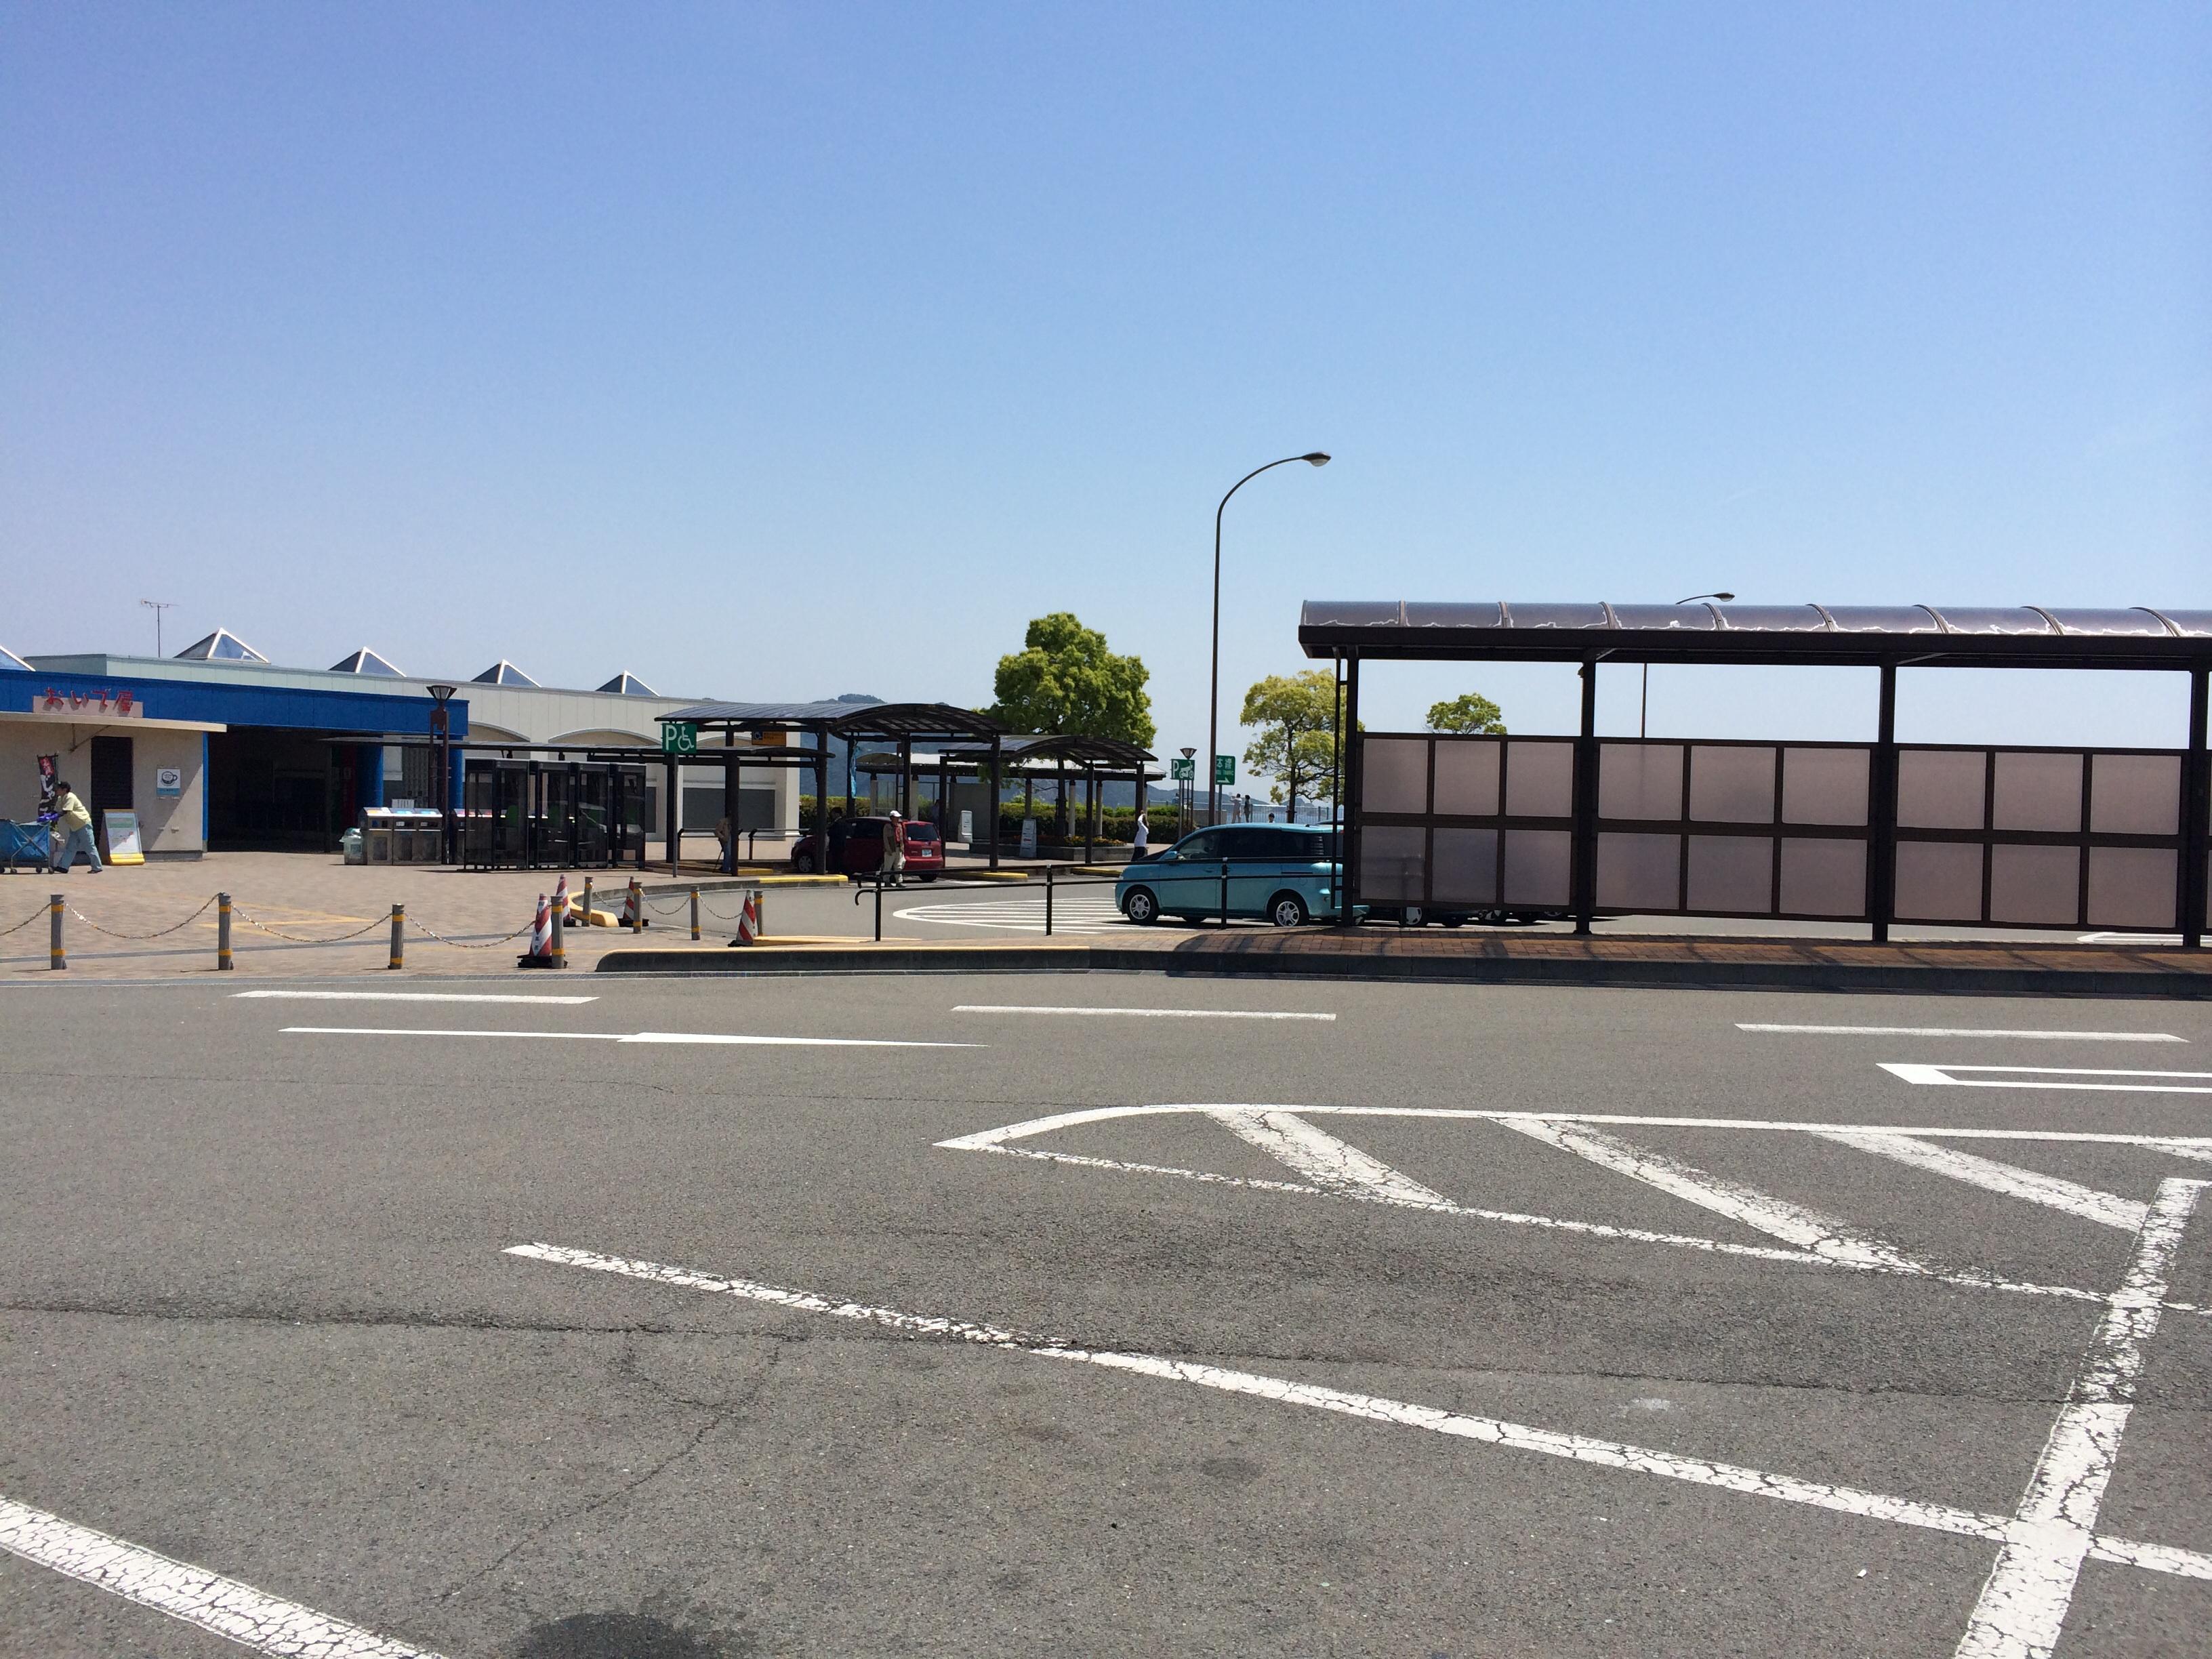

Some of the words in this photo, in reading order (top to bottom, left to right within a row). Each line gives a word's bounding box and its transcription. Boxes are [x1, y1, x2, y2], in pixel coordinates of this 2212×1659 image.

[45, 687, 133, 712] おいで屋
[665, 724, 677, 751] P
[1172, 760, 1179, 778] P
